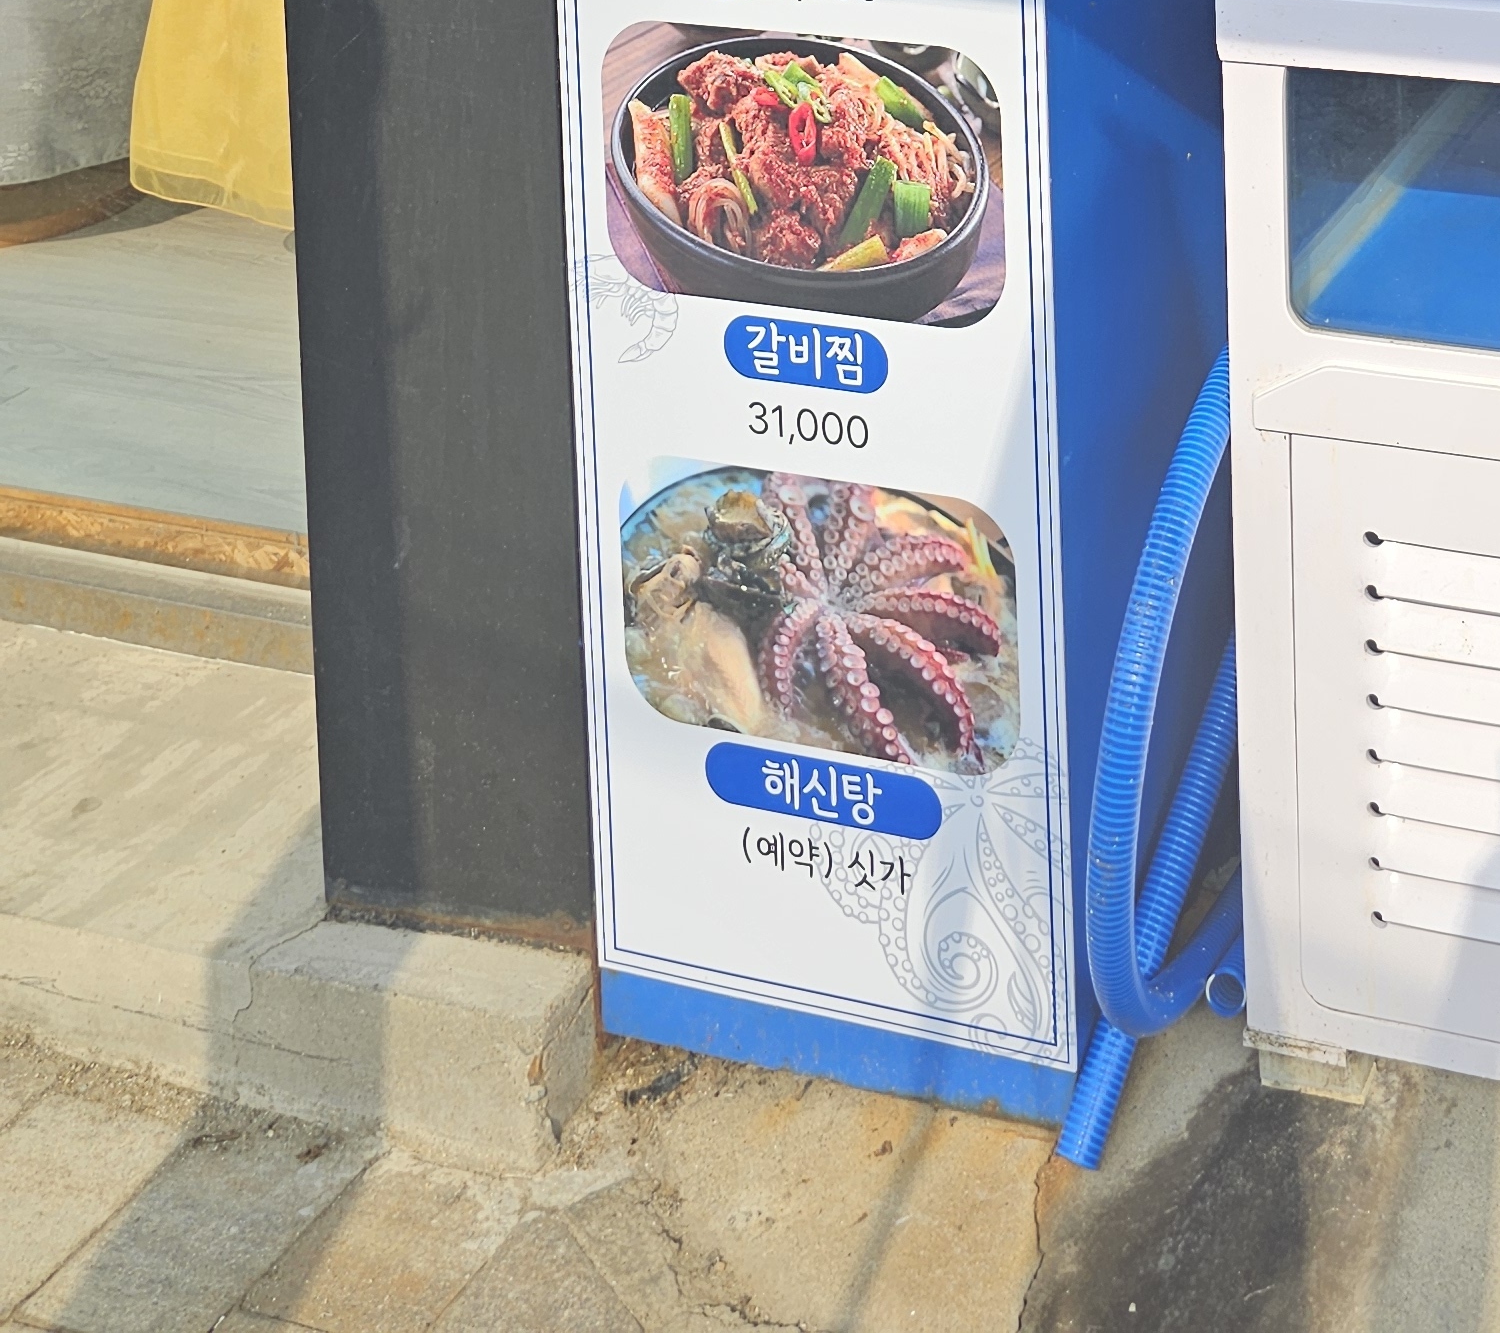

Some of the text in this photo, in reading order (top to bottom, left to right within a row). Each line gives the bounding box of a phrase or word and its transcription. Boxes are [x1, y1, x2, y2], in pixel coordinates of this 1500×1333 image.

[745, 321, 863, 386] 갈비찜
[748, 401, 869, 449] 31,000
[761, 758, 883, 825] 해신탕
[742, 826, 912, 896] (예약) 싯가
